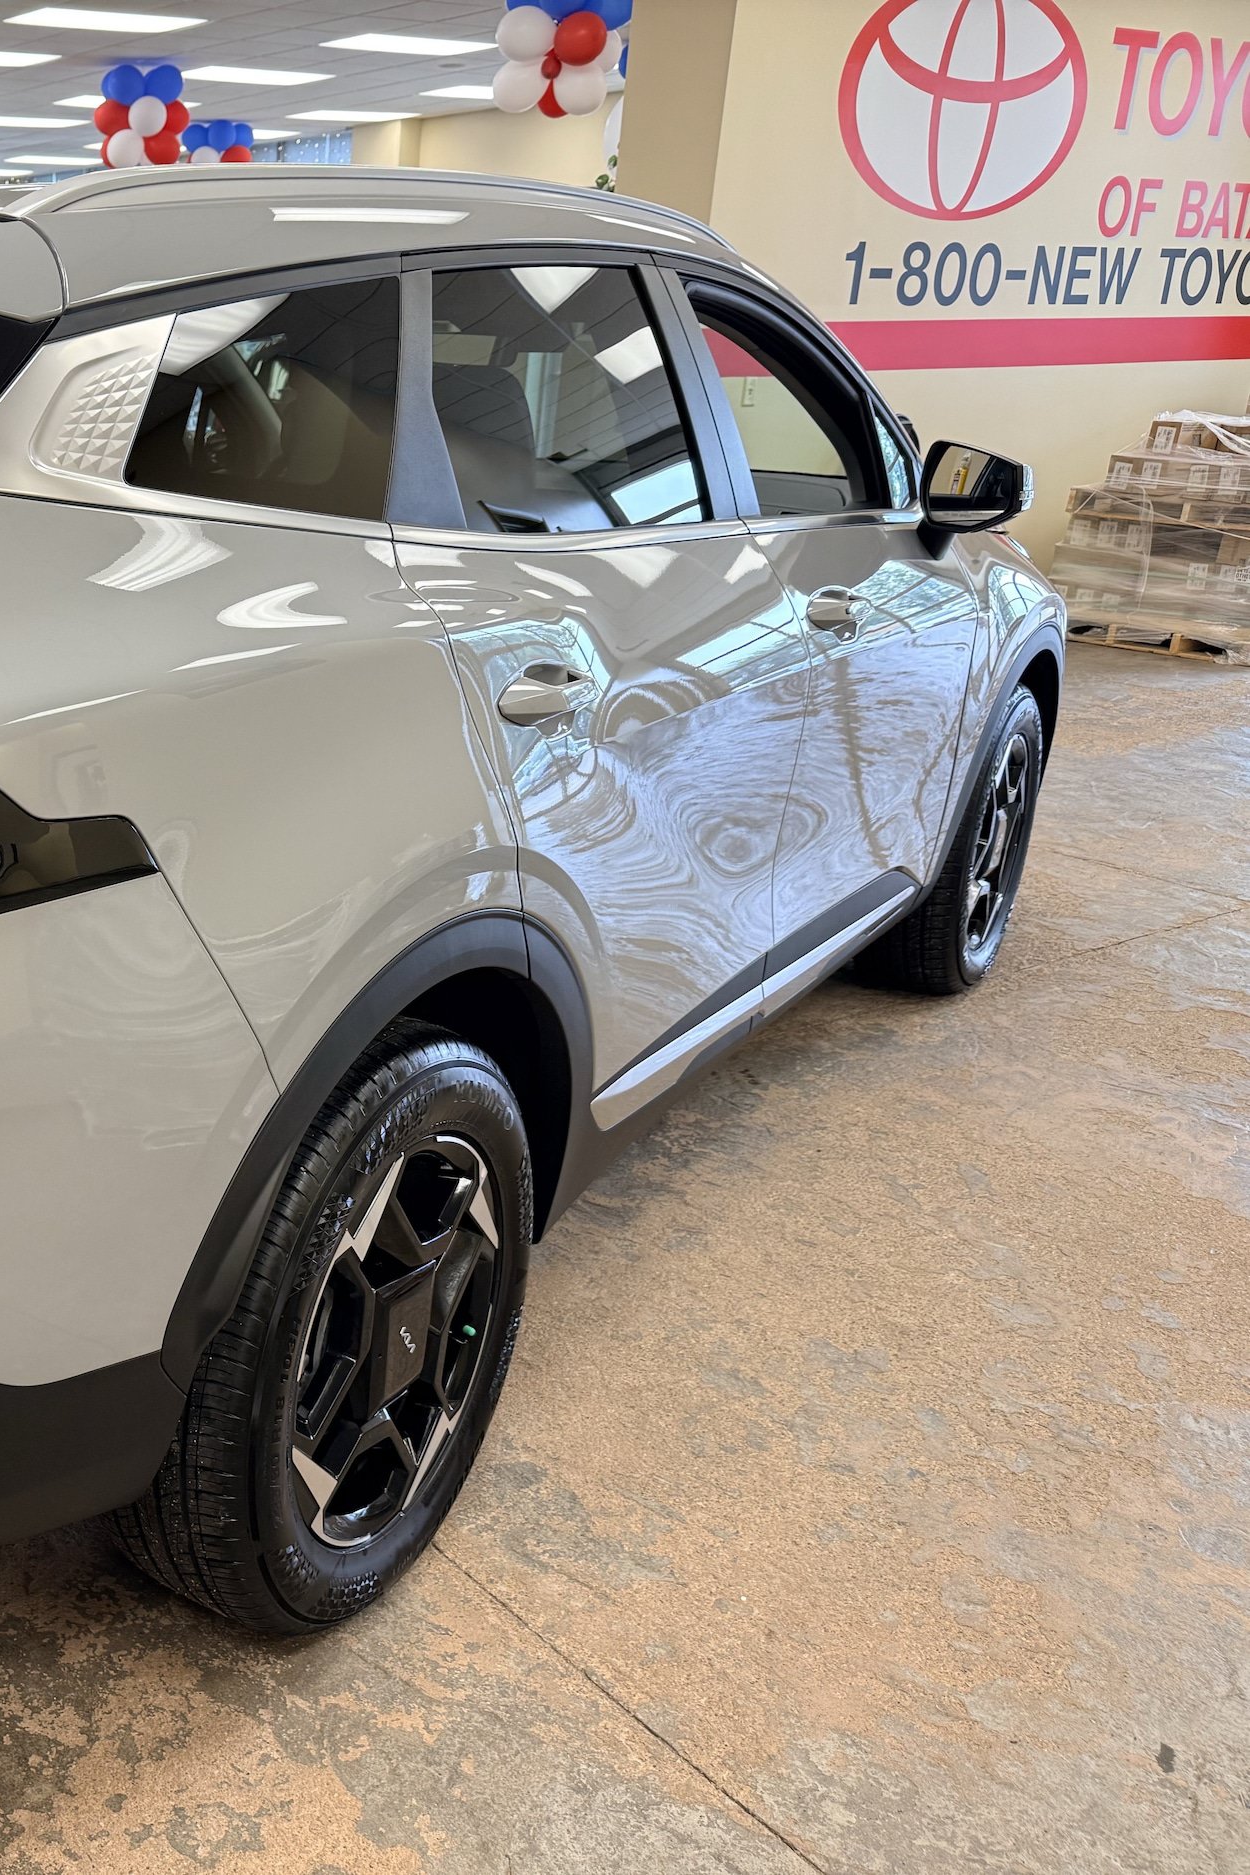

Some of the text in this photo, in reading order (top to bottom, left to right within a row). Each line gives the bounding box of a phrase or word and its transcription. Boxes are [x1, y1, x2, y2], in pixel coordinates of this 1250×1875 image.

[1098, 175, 1250, 239] OF BAT
[845, 241, 1142, 307] 1-800-NEW
